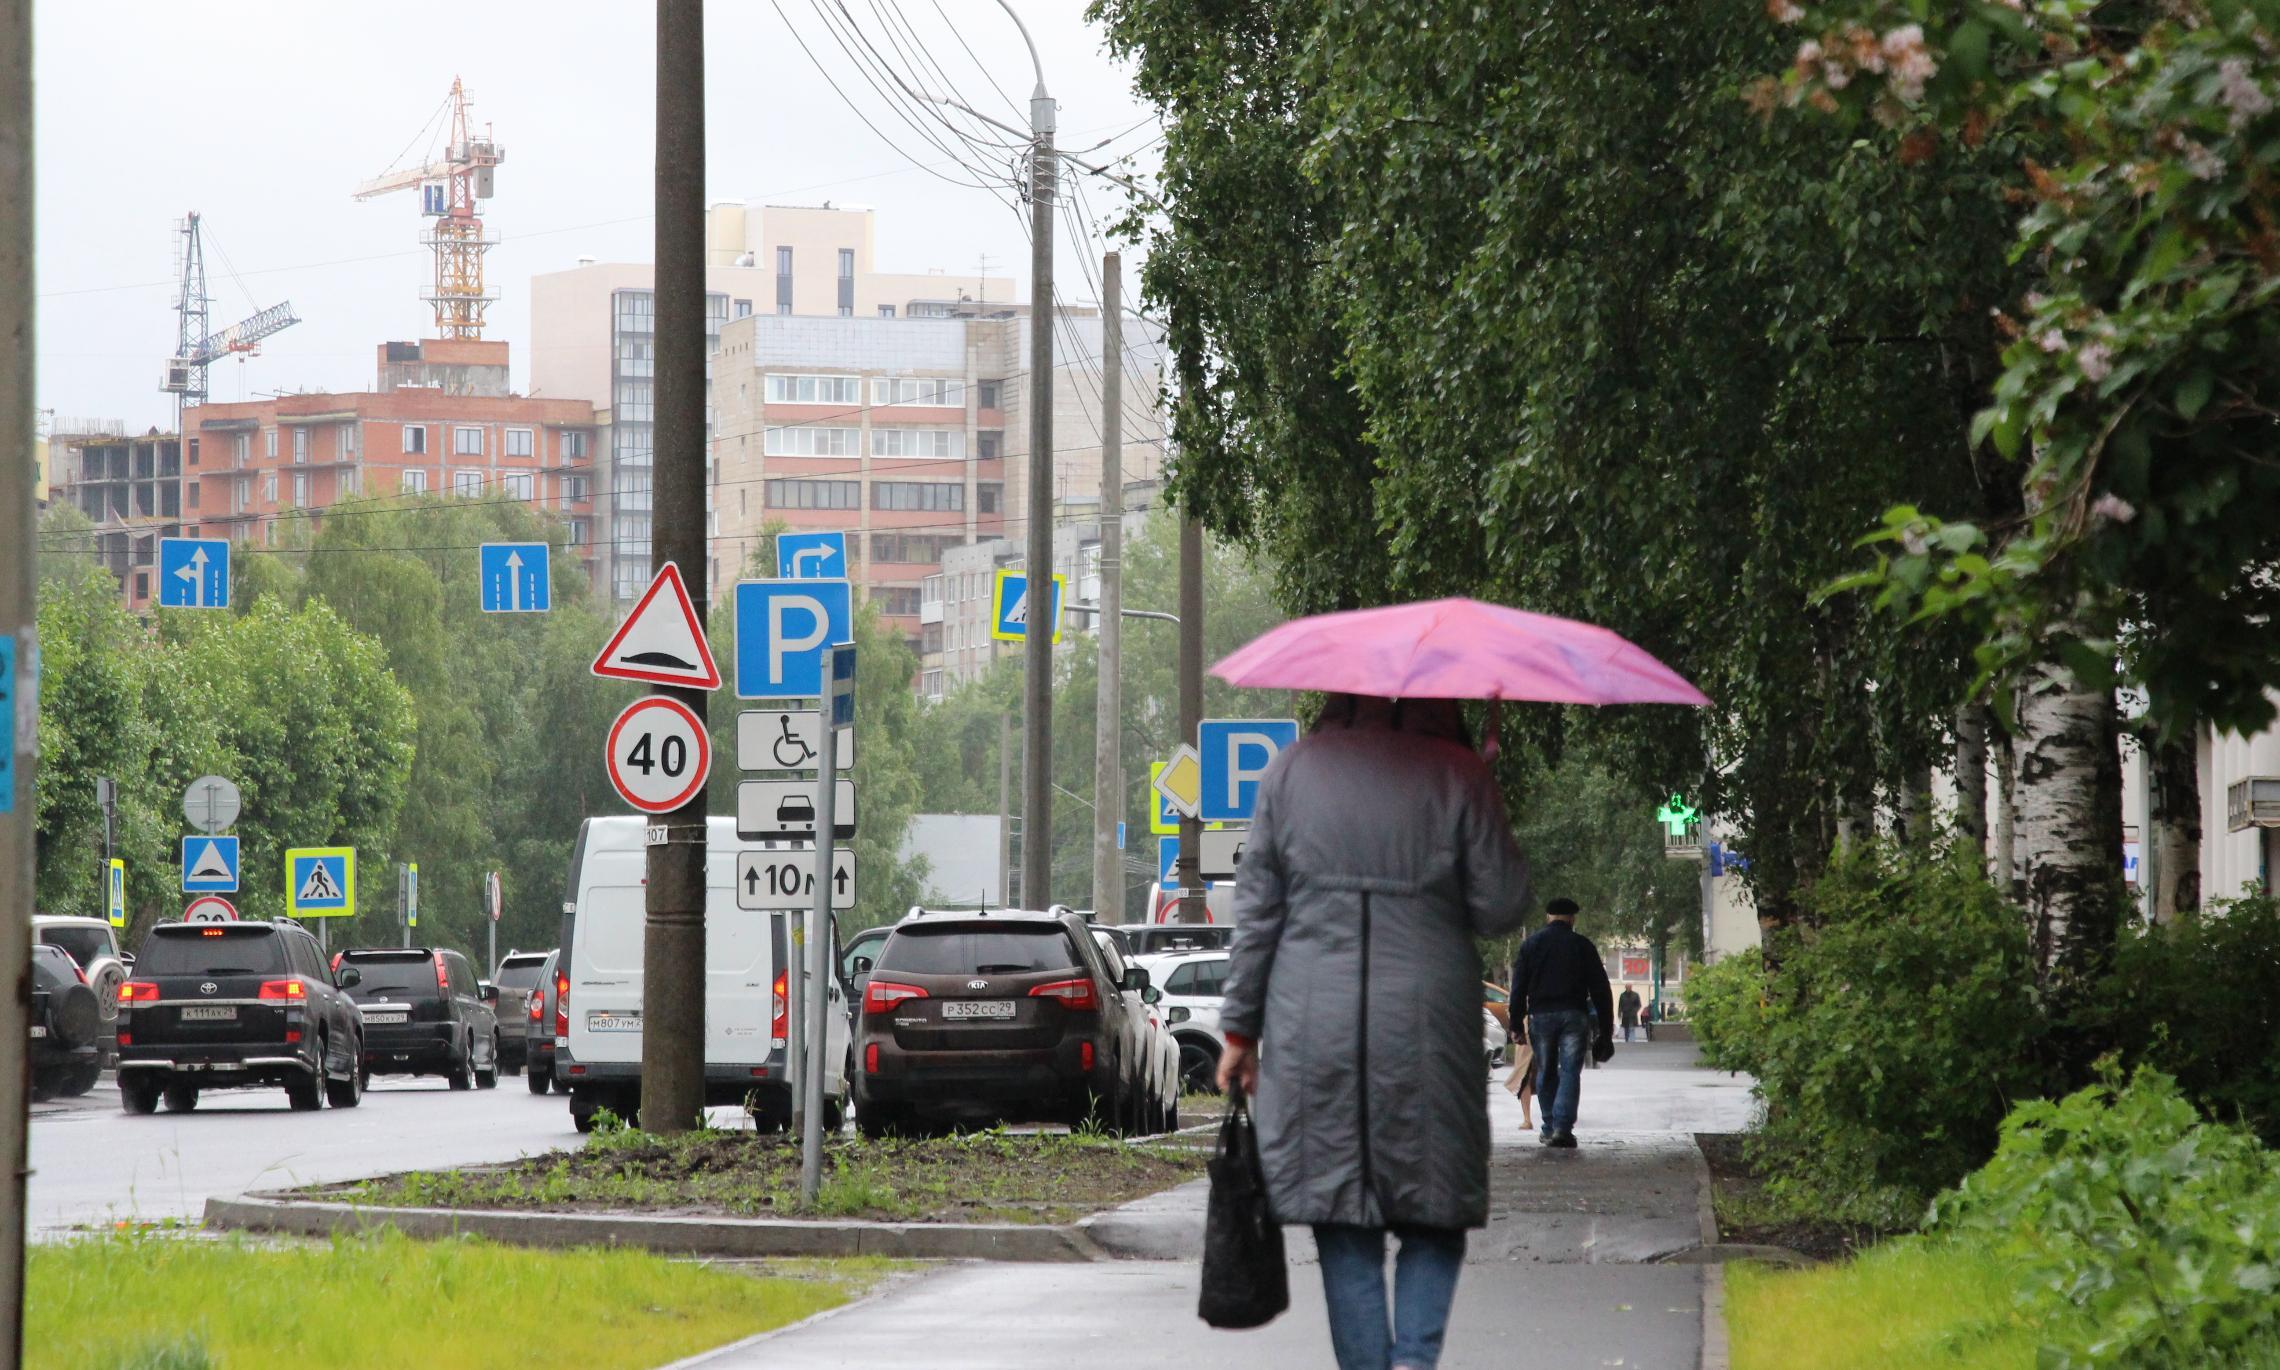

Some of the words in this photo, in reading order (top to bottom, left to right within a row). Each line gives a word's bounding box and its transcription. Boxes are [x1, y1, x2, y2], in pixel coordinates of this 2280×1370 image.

[768, 595, 829, 684] P
[627, 733, 686, 777] 40
[1228, 733, 1278, 808] P
[647, 828, 664, 841] 107
[970, 981, 987, 989] KIA
